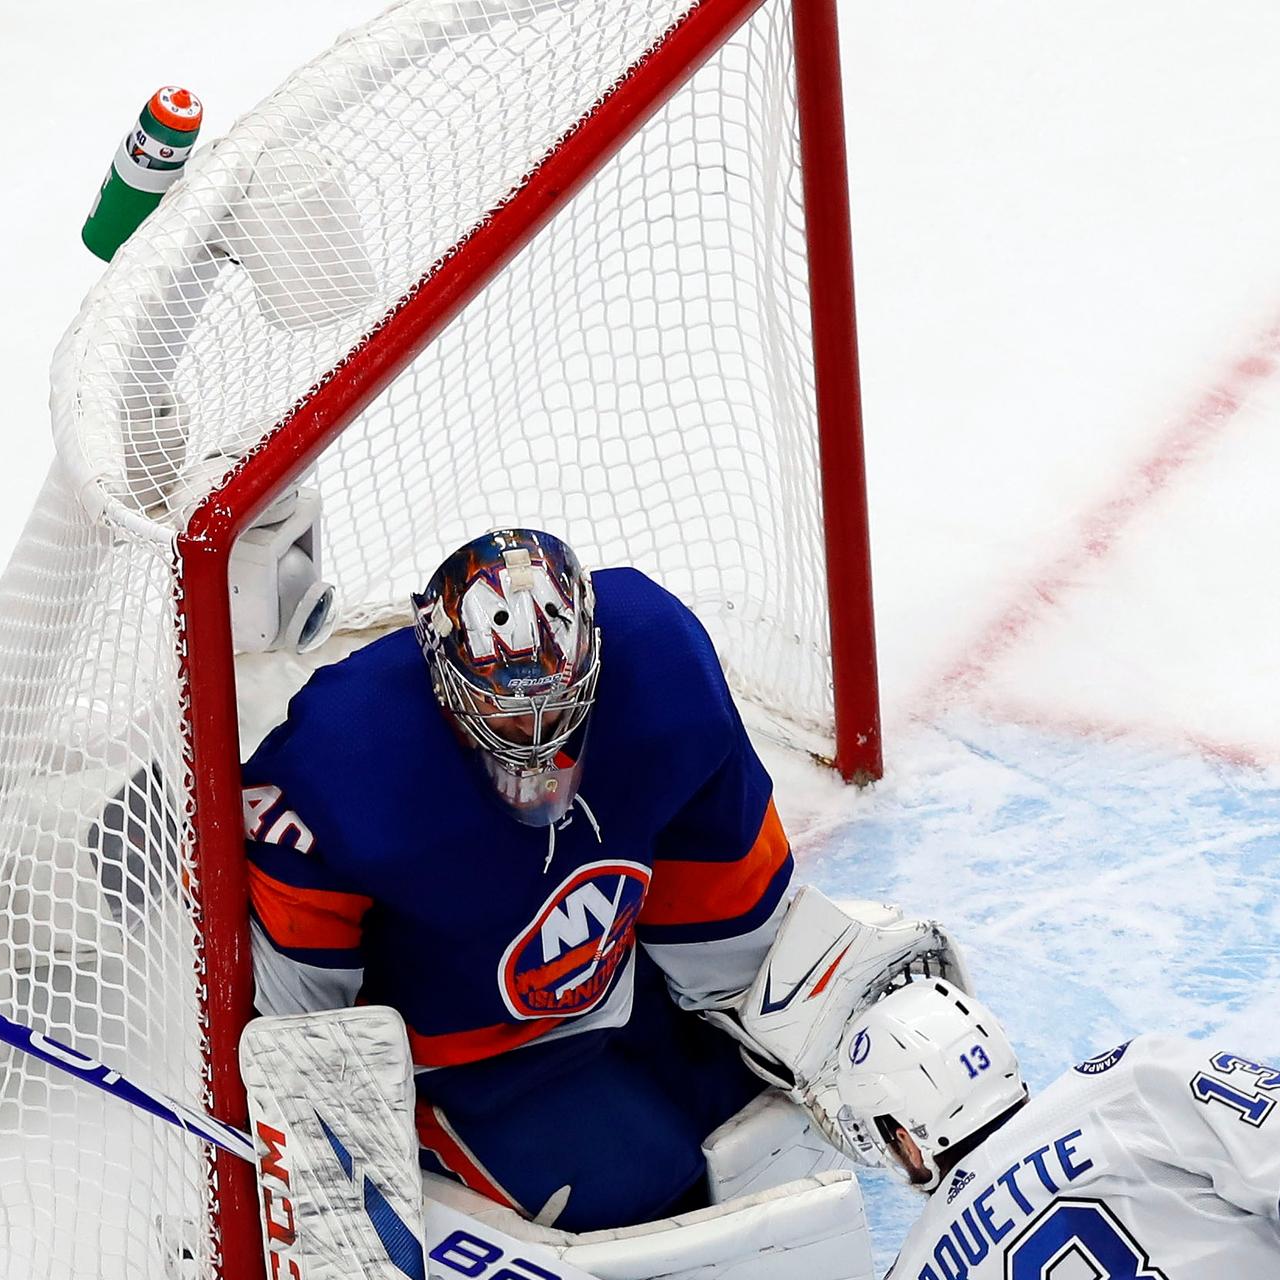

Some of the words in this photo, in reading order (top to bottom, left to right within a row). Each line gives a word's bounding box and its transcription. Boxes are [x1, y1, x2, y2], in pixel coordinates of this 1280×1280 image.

[959, 1044, 991, 1080] 13
[1082, 1053, 1118, 1073] TAMPA
[946, 1171, 977, 1206] adidas
